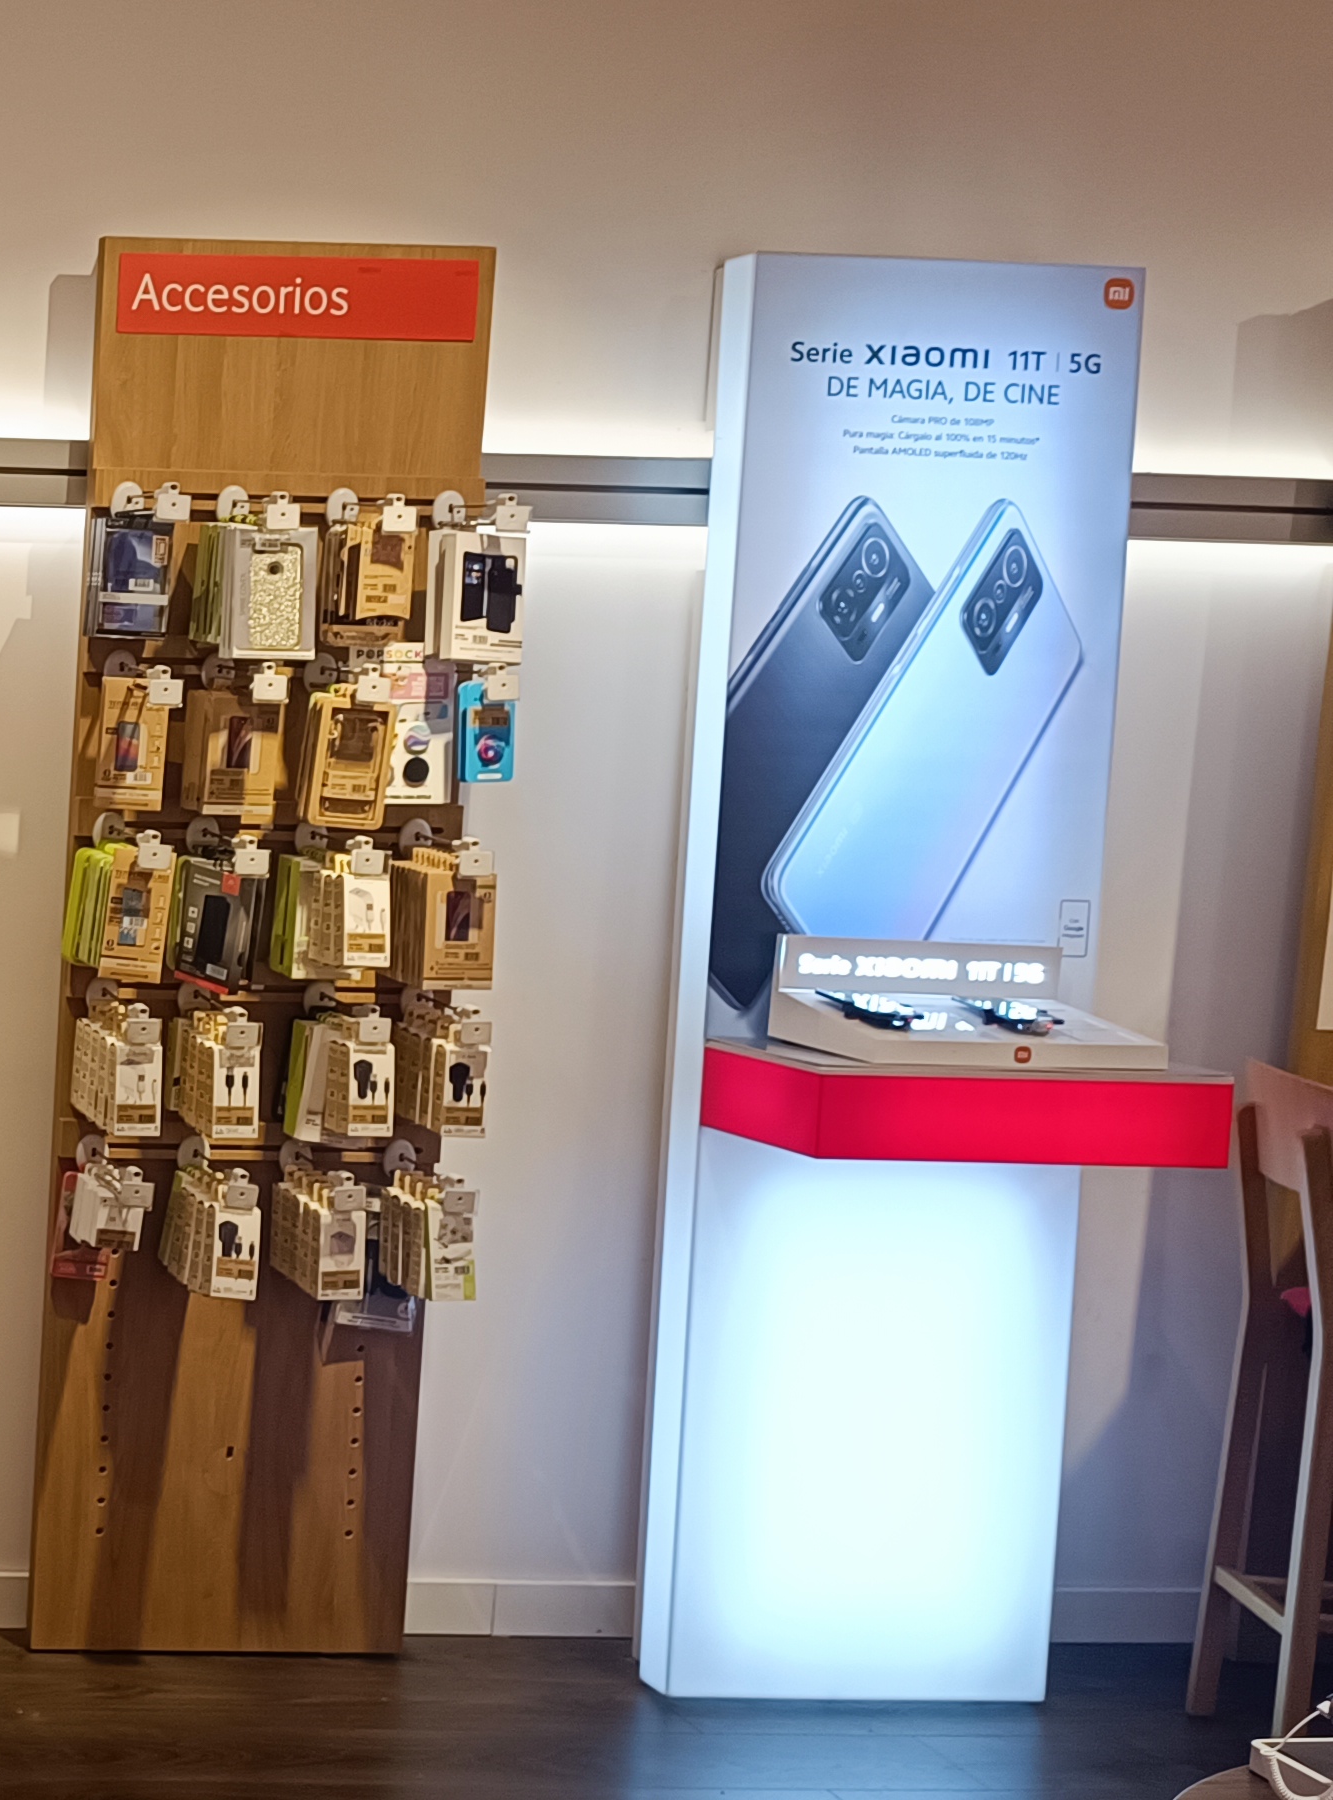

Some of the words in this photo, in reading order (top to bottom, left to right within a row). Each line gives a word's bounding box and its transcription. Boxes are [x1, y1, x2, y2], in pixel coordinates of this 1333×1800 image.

[131, 273, 350, 317] Accesorios
[790, 341, 853, 364] Serie
[1008, 350, 1047, 371] 11T
[1068, 353, 1101, 374] 5G
[827, 376, 859, 397] DE
[868, 378, 955, 404] MAGIA,
[964, 381, 995, 402] DE
[1003, 383, 1060, 405] CINE
[928, 416, 947, 425] PRO
[950, 417, 961, 425] de
[946, 432, 970, 442] 100%
[987, 434, 996, 443] 15
[892, 447, 931, 456] AMOLED
